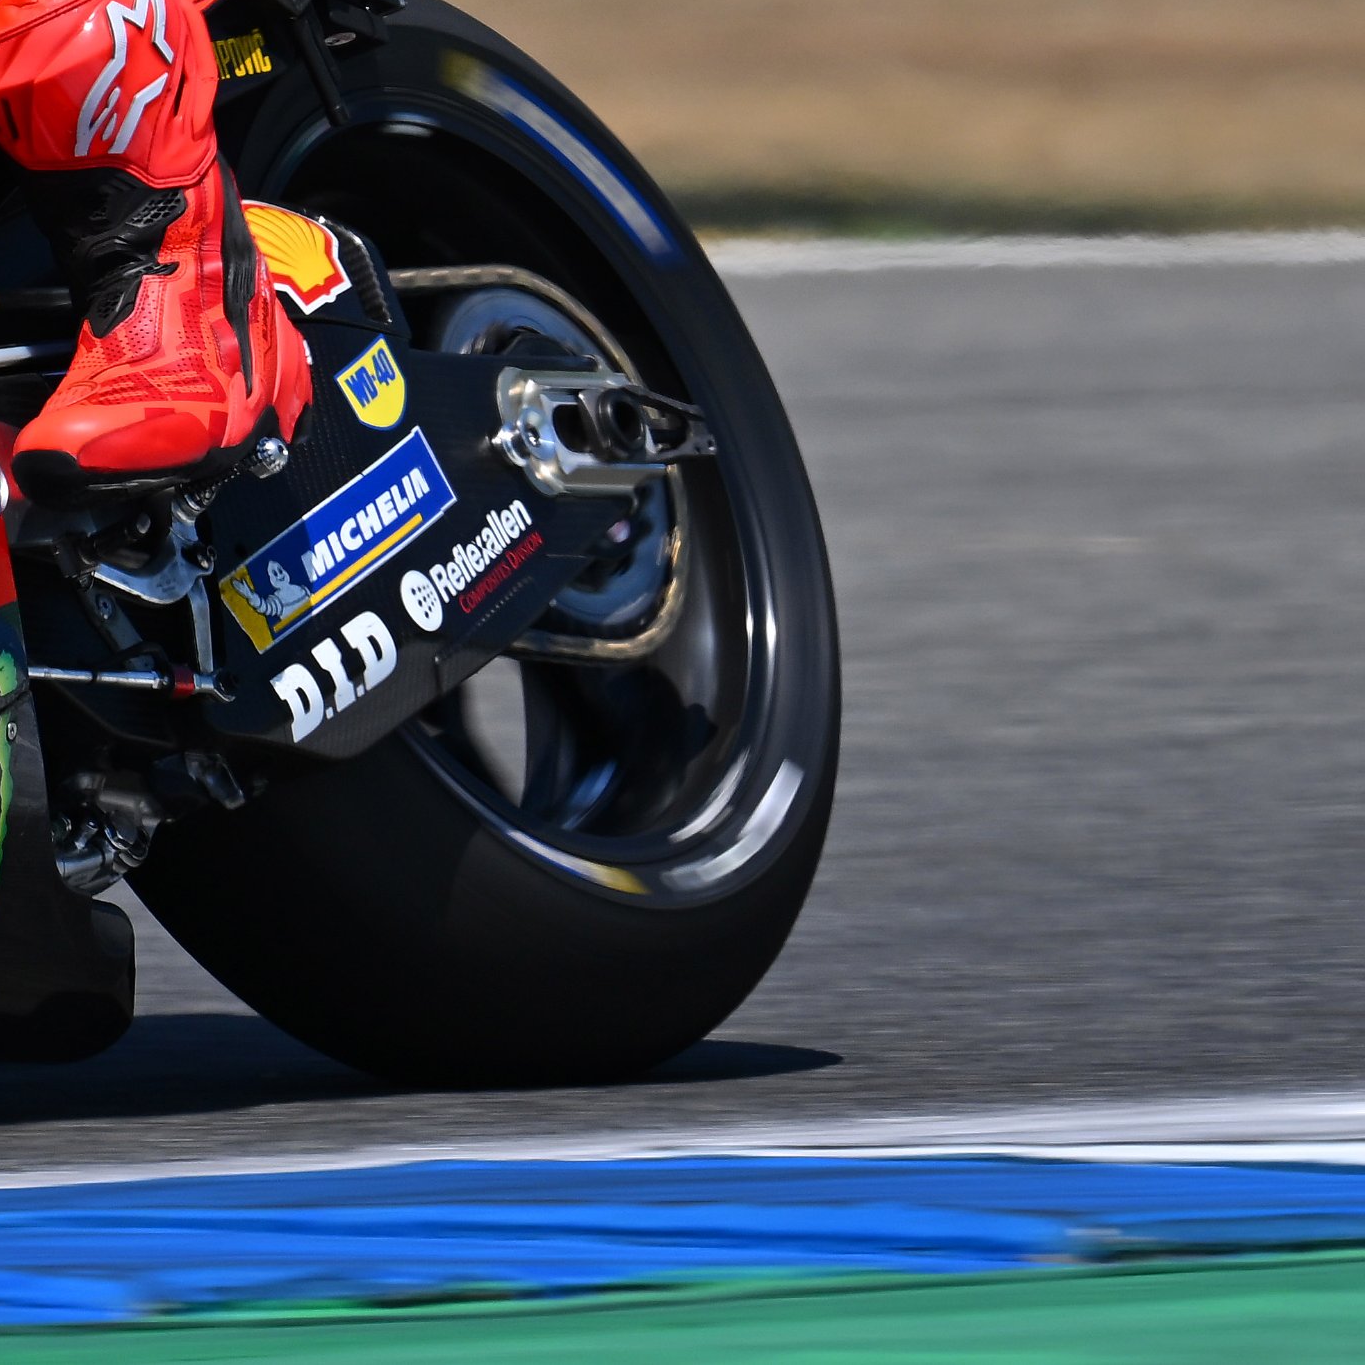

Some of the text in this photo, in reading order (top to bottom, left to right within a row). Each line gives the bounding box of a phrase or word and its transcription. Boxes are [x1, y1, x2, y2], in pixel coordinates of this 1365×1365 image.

[344, 347, 396, 407] WD-40
[300, 467, 430, 583] MICHELIN
[429, 499, 533, 604] Reflexallen
[269, 610, 399, 743] D.I.D
